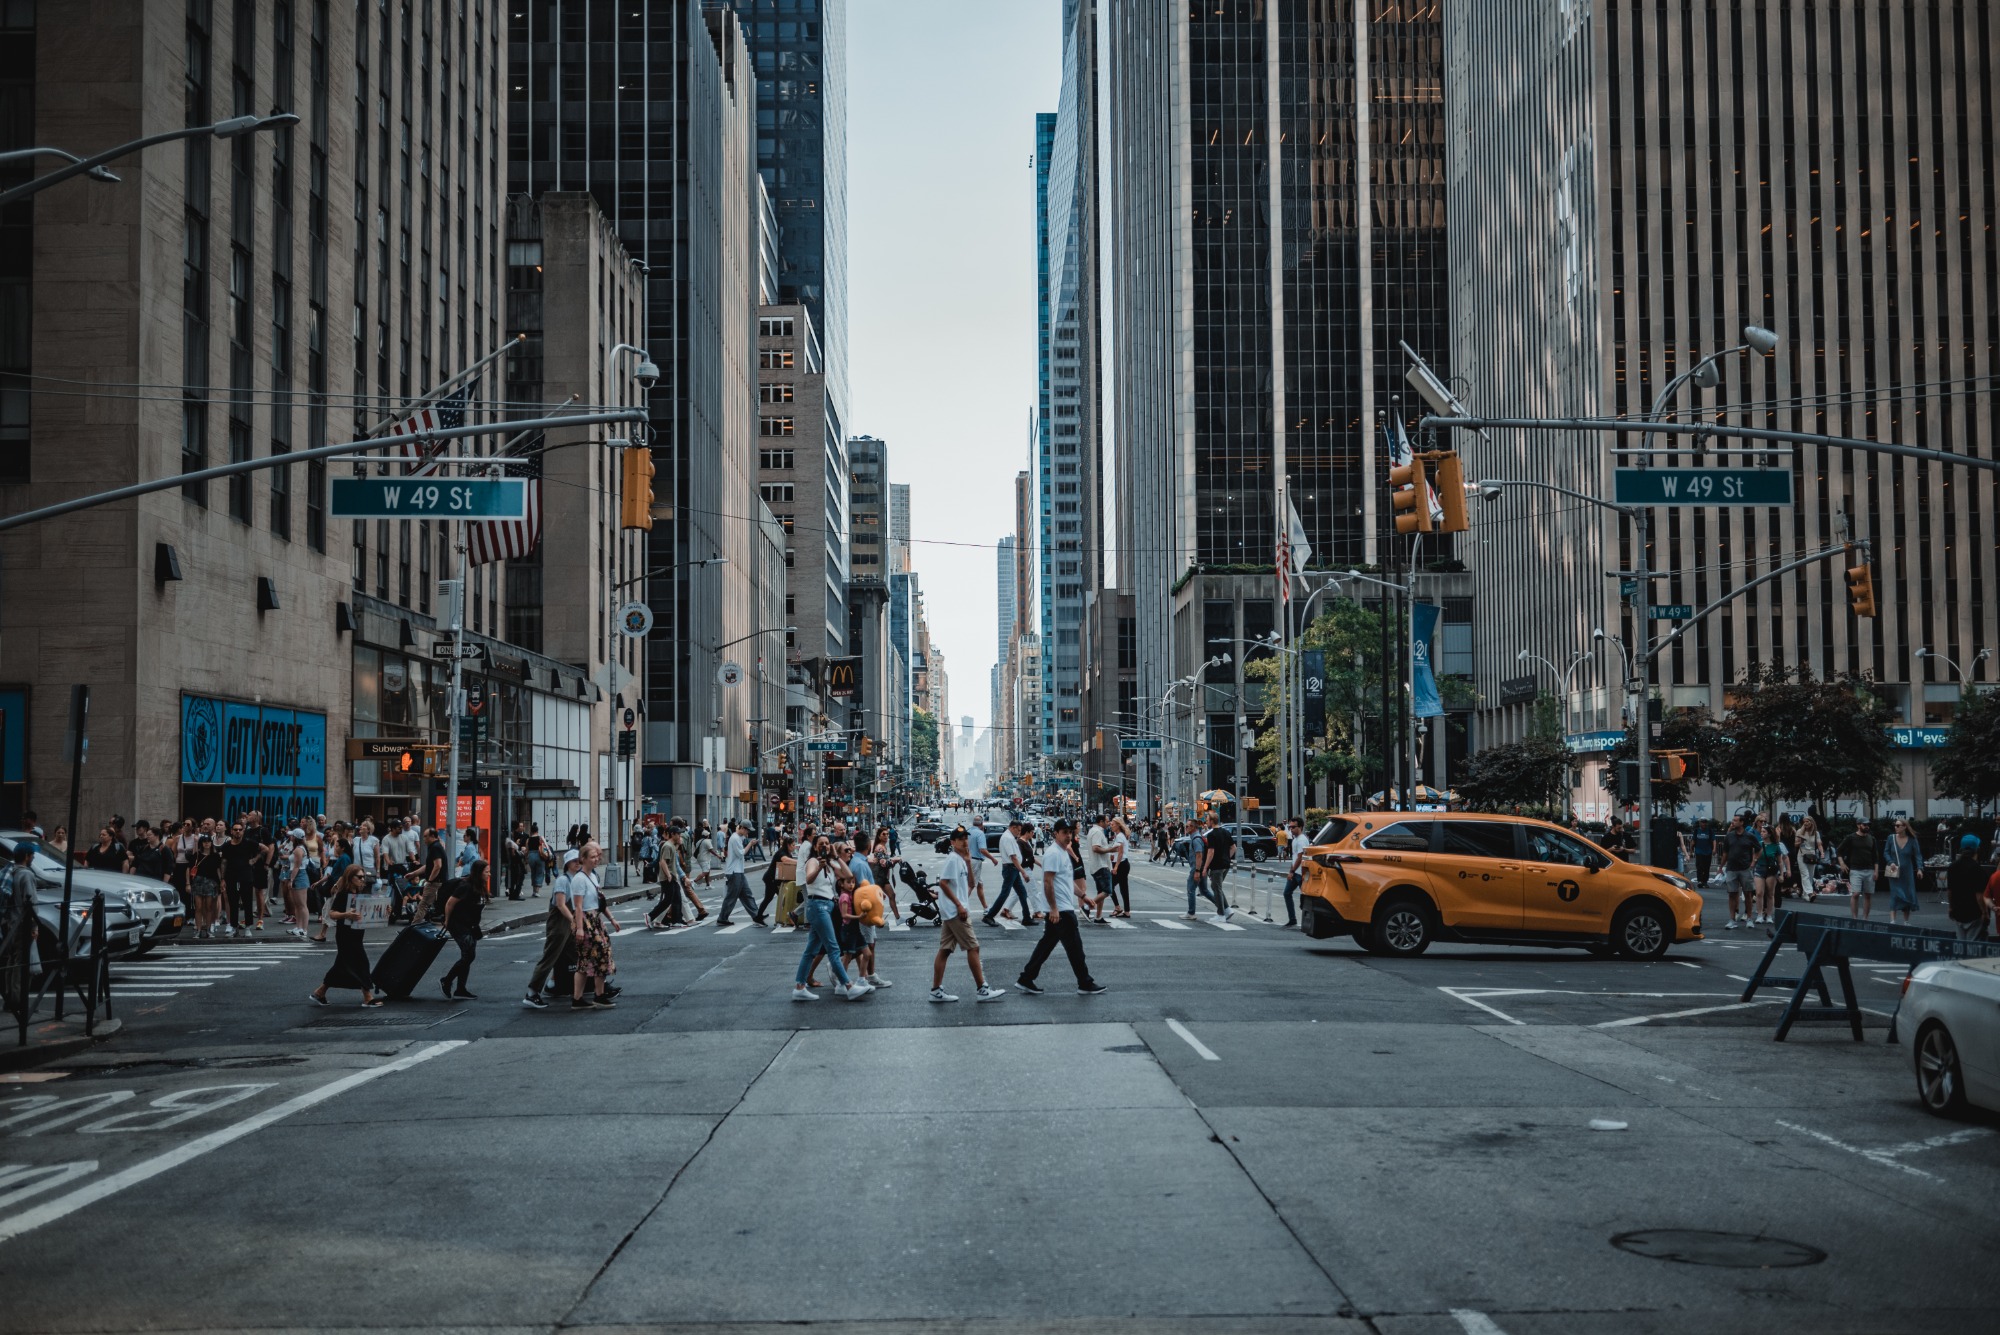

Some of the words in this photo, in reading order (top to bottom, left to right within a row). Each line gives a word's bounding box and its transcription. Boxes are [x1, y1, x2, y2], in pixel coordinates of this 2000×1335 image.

[1661, 476, 1678, 498] W
[1686, 476, 1713, 498] 49
[1722, 476, 1744, 498] St
[383, 486, 401, 510] W
[409, 486, 440, 510] 49
[449, 486, 473, 510] St
[1658, 607, 1666, 617] W
[1668, 607, 1681, 617] 49
[227, 716, 261, 775] CITY
[261, 720, 303, 777] STORE
[766, 779, 786, 787] 1212
[1890, 937, 1917, 950] POLICE
[1923, 940, 1941, 953] LINE
[1953, 943, 1963, 954] DO
[1967, 944, 1983, 956] NOT
